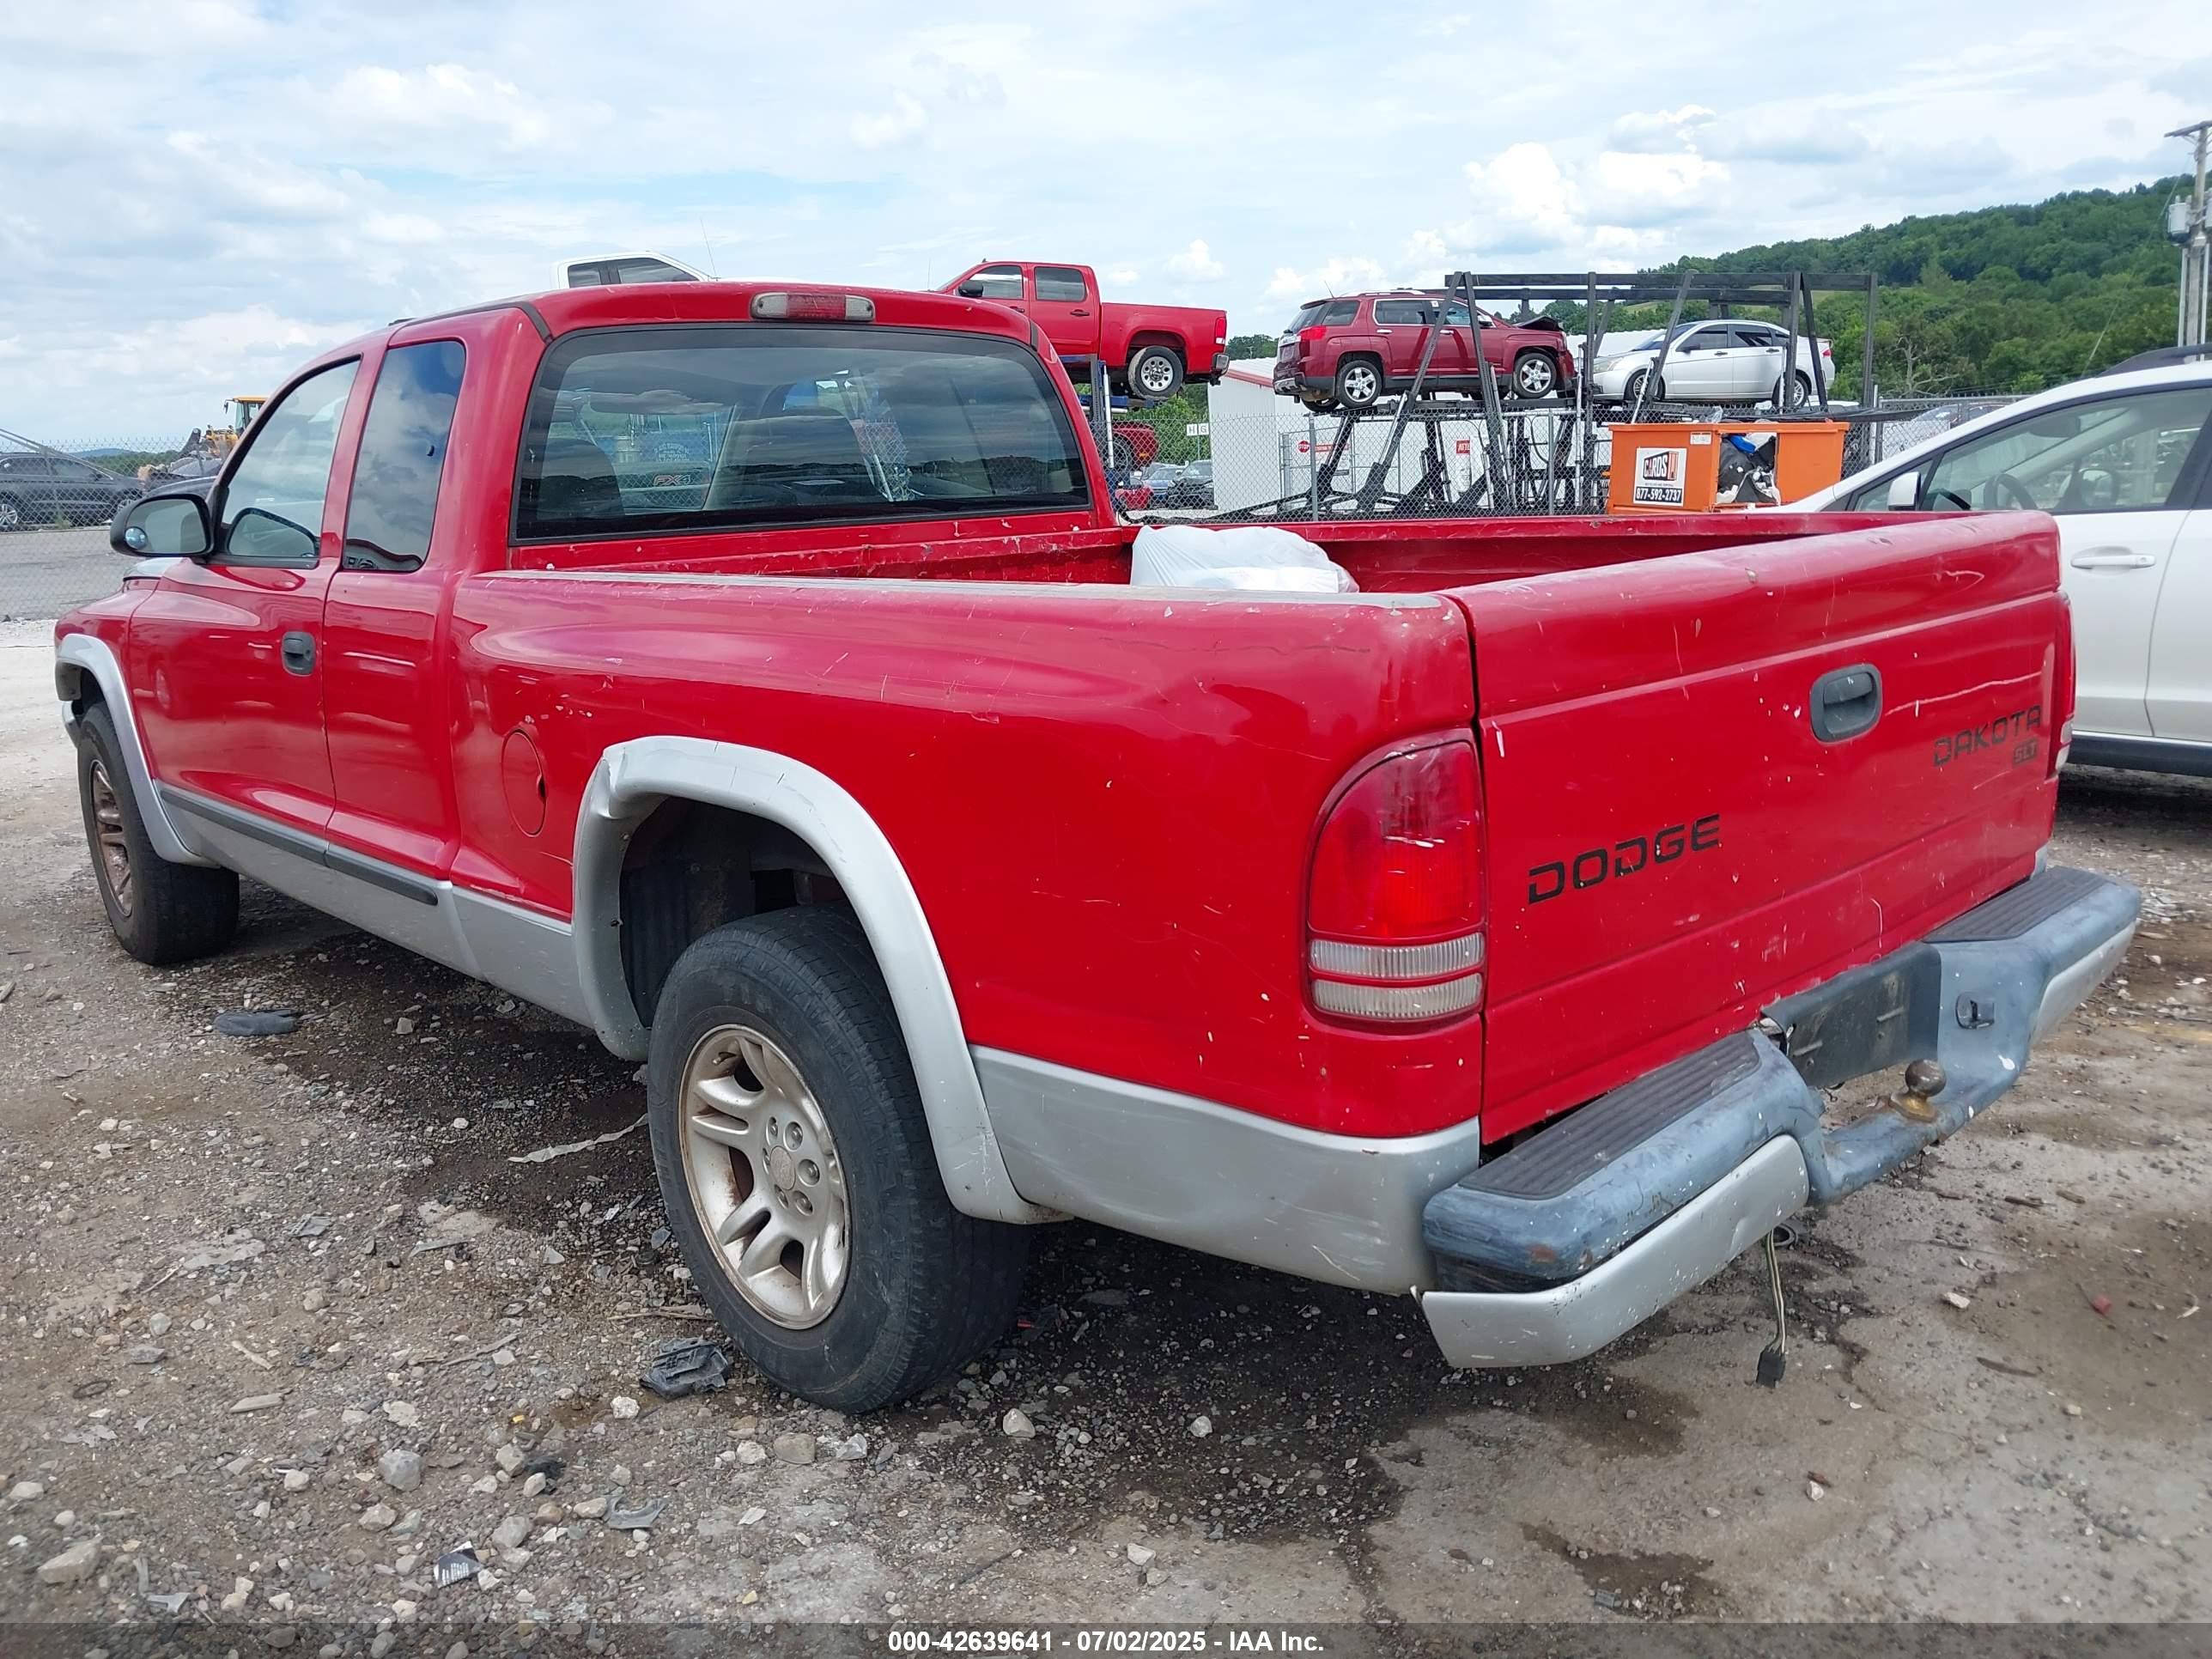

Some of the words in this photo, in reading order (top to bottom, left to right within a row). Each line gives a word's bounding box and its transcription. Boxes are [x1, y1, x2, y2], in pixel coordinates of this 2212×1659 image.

[1644, 454, 1668, 477] CARDS
[653, 474, 690, 486] FX4
[1636, 487, 1681, 502] 877-592-2737
[1934, 704, 2042, 767] DAKOTA
[1528, 813, 1721, 905] DODGE
